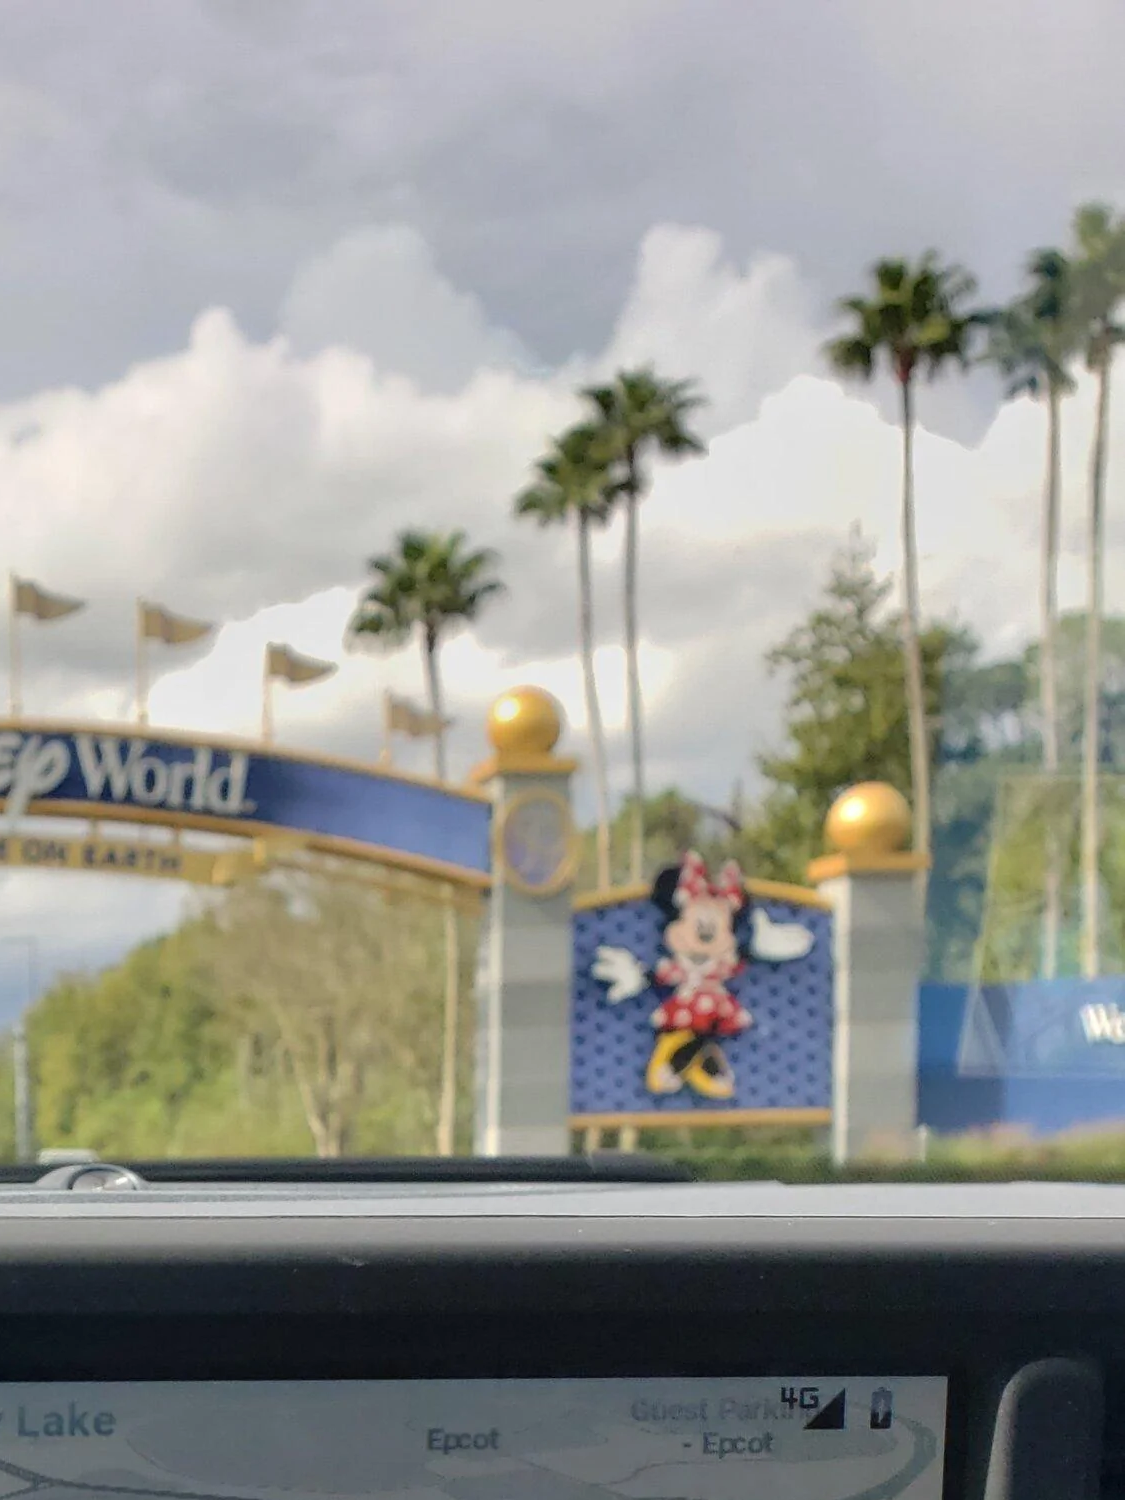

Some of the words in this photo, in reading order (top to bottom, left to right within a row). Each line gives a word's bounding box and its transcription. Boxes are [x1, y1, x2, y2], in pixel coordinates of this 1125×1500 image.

[77, 735, 256, 812] World
[24, 838, 67, 863] ON
[83, 845, 183, 873] EARTH
[780, 1386, 820, 1410] 4G
[17, 1402, 116, 1438] Lake
[427, 1427, 500, 1455] Epcot
[703, 1431, 774, 1459] Epcot
